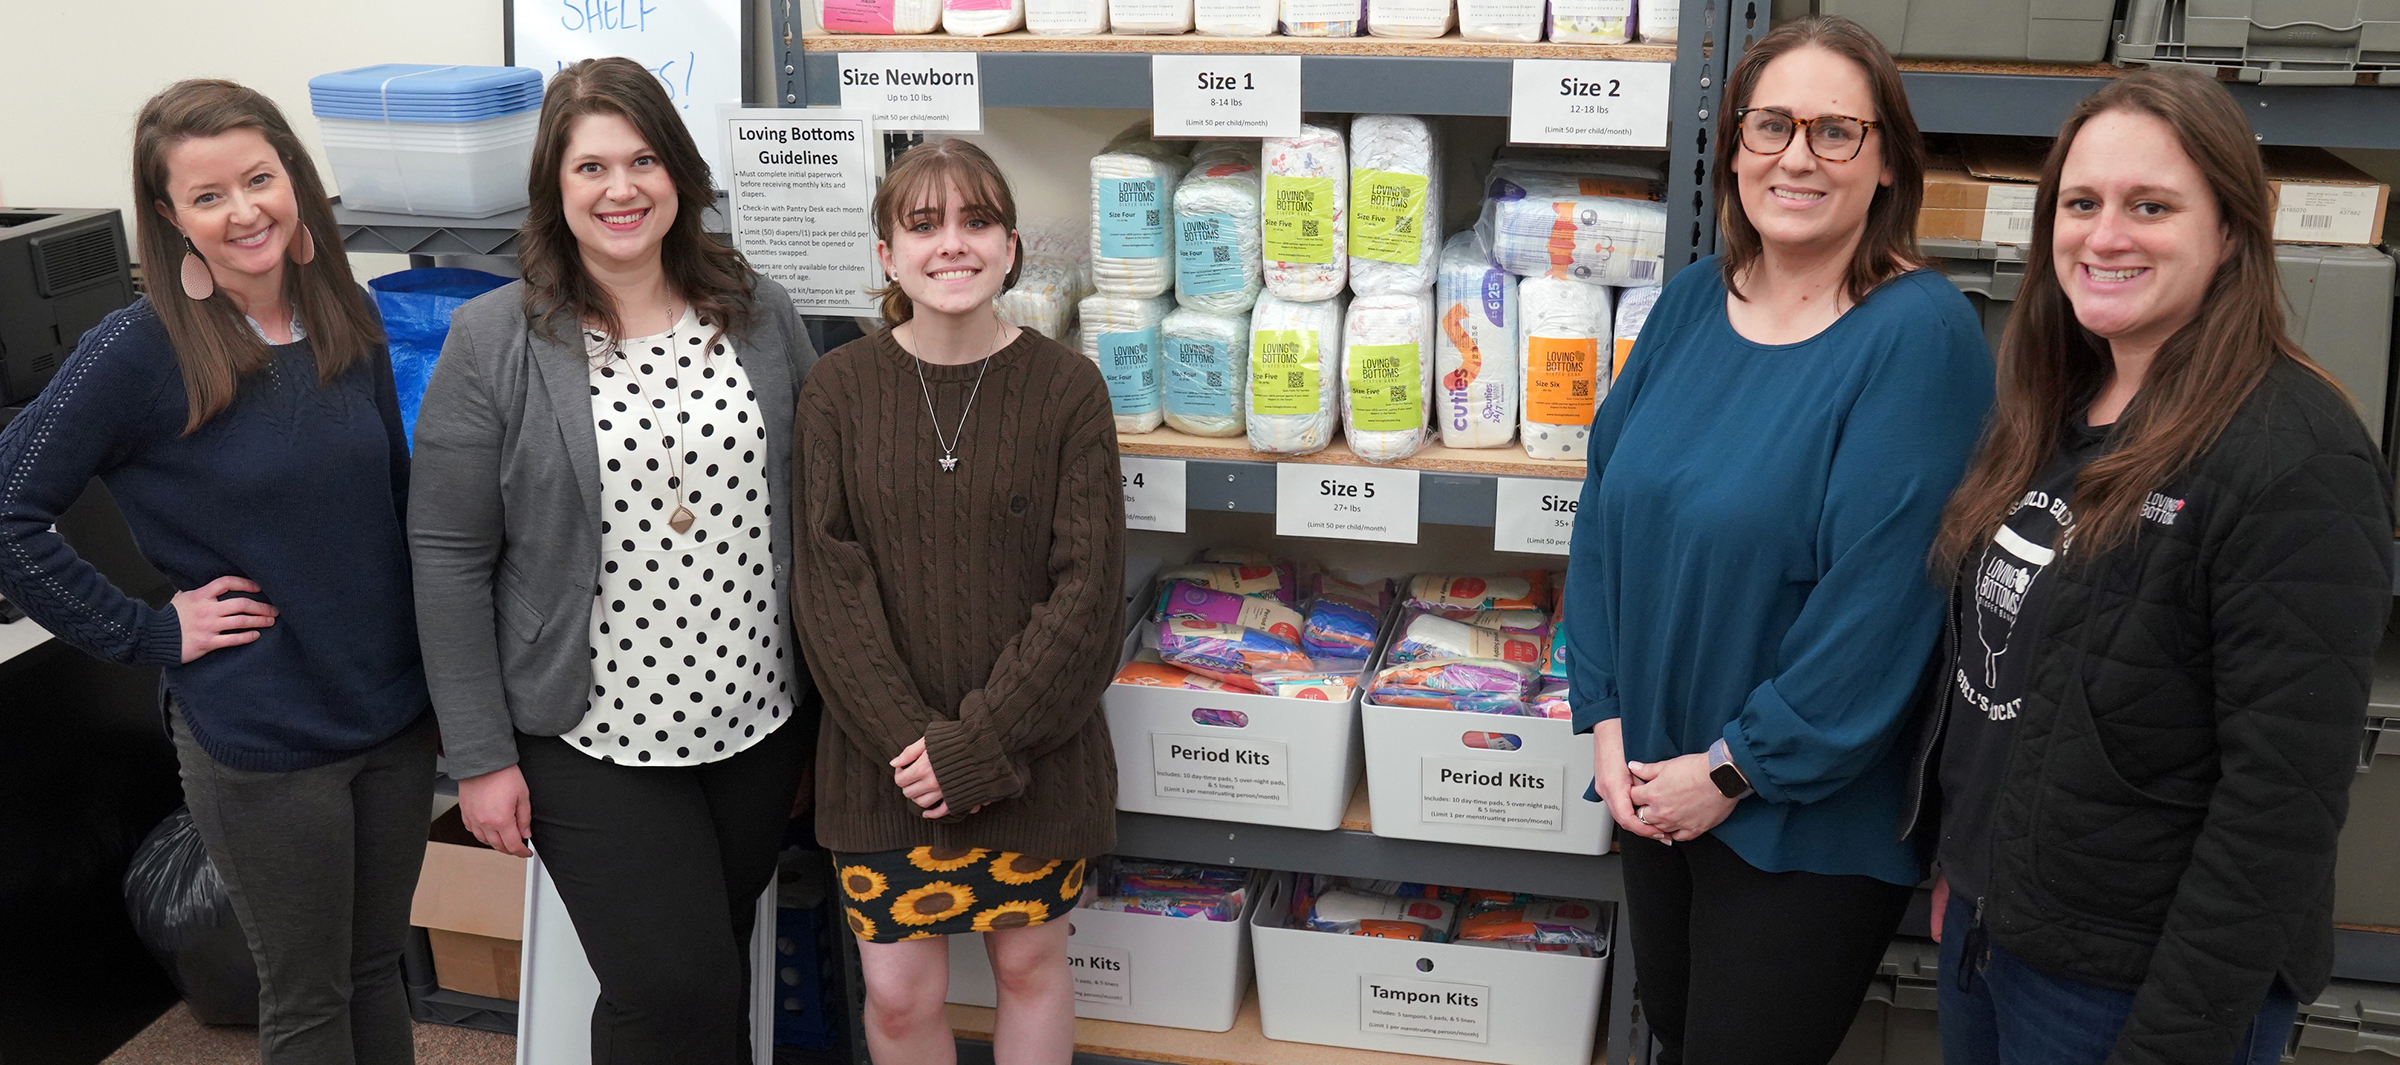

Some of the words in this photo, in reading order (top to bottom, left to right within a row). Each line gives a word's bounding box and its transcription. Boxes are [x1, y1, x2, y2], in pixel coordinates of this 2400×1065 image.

[843, 68, 879, 86] Size
[886, 68, 974, 86] Newborn
[1198, 72, 1236, 90] Size
[1244, 72, 1254, 90] 1
[1560, 77, 1601, 96] Size
[1608, 79, 1620, 97] 2
[887, 94, 898, 102] Up
[920, 94, 932, 102] lbs
[1210, 98, 1228, 106] 8-14
[1230, 98, 1242, 106] lbs
[1570, 105, 1594, 114] 12-18
[1596, 106, 1609, 114] lbs
[872, 114, 889, 122] (Limit
[910, 114, 949, 122] child/month)
[739, 126, 787, 144] Loving
[792, 127, 855, 141] Bottoms
[1544, 126, 1564, 134] (Limit
[1588, 127, 1632, 136] child/month)
[758, 150, 838, 164] Guidelines
[808, 172, 843, 180] paperwork
[792, 182, 819, 190] monthly
[1118, 182, 1146, 192] LOVING
[1372, 184, 1400, 197] LOVING
[1118, 192, 1154, 202] BOTTOMS
[1276, 190, 1304, 202] LOVING
[1370, 195, 1408, 208] BOTTOMS
[742, 204, 770, 212] Check-in
[786, 206, 808, 214] Pantry
[1276, 200, 1312, 212] BOTTOMS
[744, 214, 752, 222] for
[782, 216, 804, 224] pantry
[804, 216, 816, 224] log.
[1265, 218, 1278, 226] Size
[1278, 220, 1292, 228] Five
[1183, 220, 1210, 232] LOVING
[776, 230, 810, 238] diapers/(1)
[812, 230, 828, 238] pack
[840, 230, 856, 238] child
[1184, 230, 1220, 242] BOTTOMS
[822, 240, 846, 248] opened
[797, 274, 811, 282] age.
[798, 288, 834, 296] kit/tampon
[1488, 282, 1500, 298] 25
[828, 298, 851, 306] month.
[1488, 302, 1500, 311] 6
[1114, 345, 1140, 356] LOVING
[1262, 344, 1289, 354] LOVING
[1114, 354, 1148, 366] BOTTOMS
[1262, 354, 1298, 364] BOTTOMS
[1546, 351, 1574, 362] LOVING
[1362, 358, 1390, 368] LOVING
[1546, 362, 1584, 372] BOTTOMS
[1362, 368, 1400, 379] BOTTOMS
[1550, 380, 1560, 388] Six
[1450, 368, 1468, 431] cuties
[1484, 384, 1493, 409] cuties
[1493, 405, 1504, 424] 24/7
[1133, 473, 1144, 488] 4
[1320, 480, 1358, 497] Size
[1364, 482, 1375, 498] 5
[1334, 504, 1348, 512] 27+
[1350, 504, 1362, 512] lbs
[1541, 495, 1579, 512] Size
[1346, 524, 1386, 532] child/month)
[1986, 556, 2020, 588] LOVING
[1980, 576, 2020, 615] BOTTOMS
[1956, 668, 1989, 712] GIRL'S
[1170, 744, 1230, 763] Period
[1236, 750, 1270, 766] Kits
[1440, 768, 1502, 786] Period
[1509, 773, 1545, 789] Kits
[1461, 798, 1488, 806] day-time
[1090, 956, 1120, 971] Kits
[1370, 984, 1440, 1004] Tampon
[1446, 992, 1479, 1008] Kits
